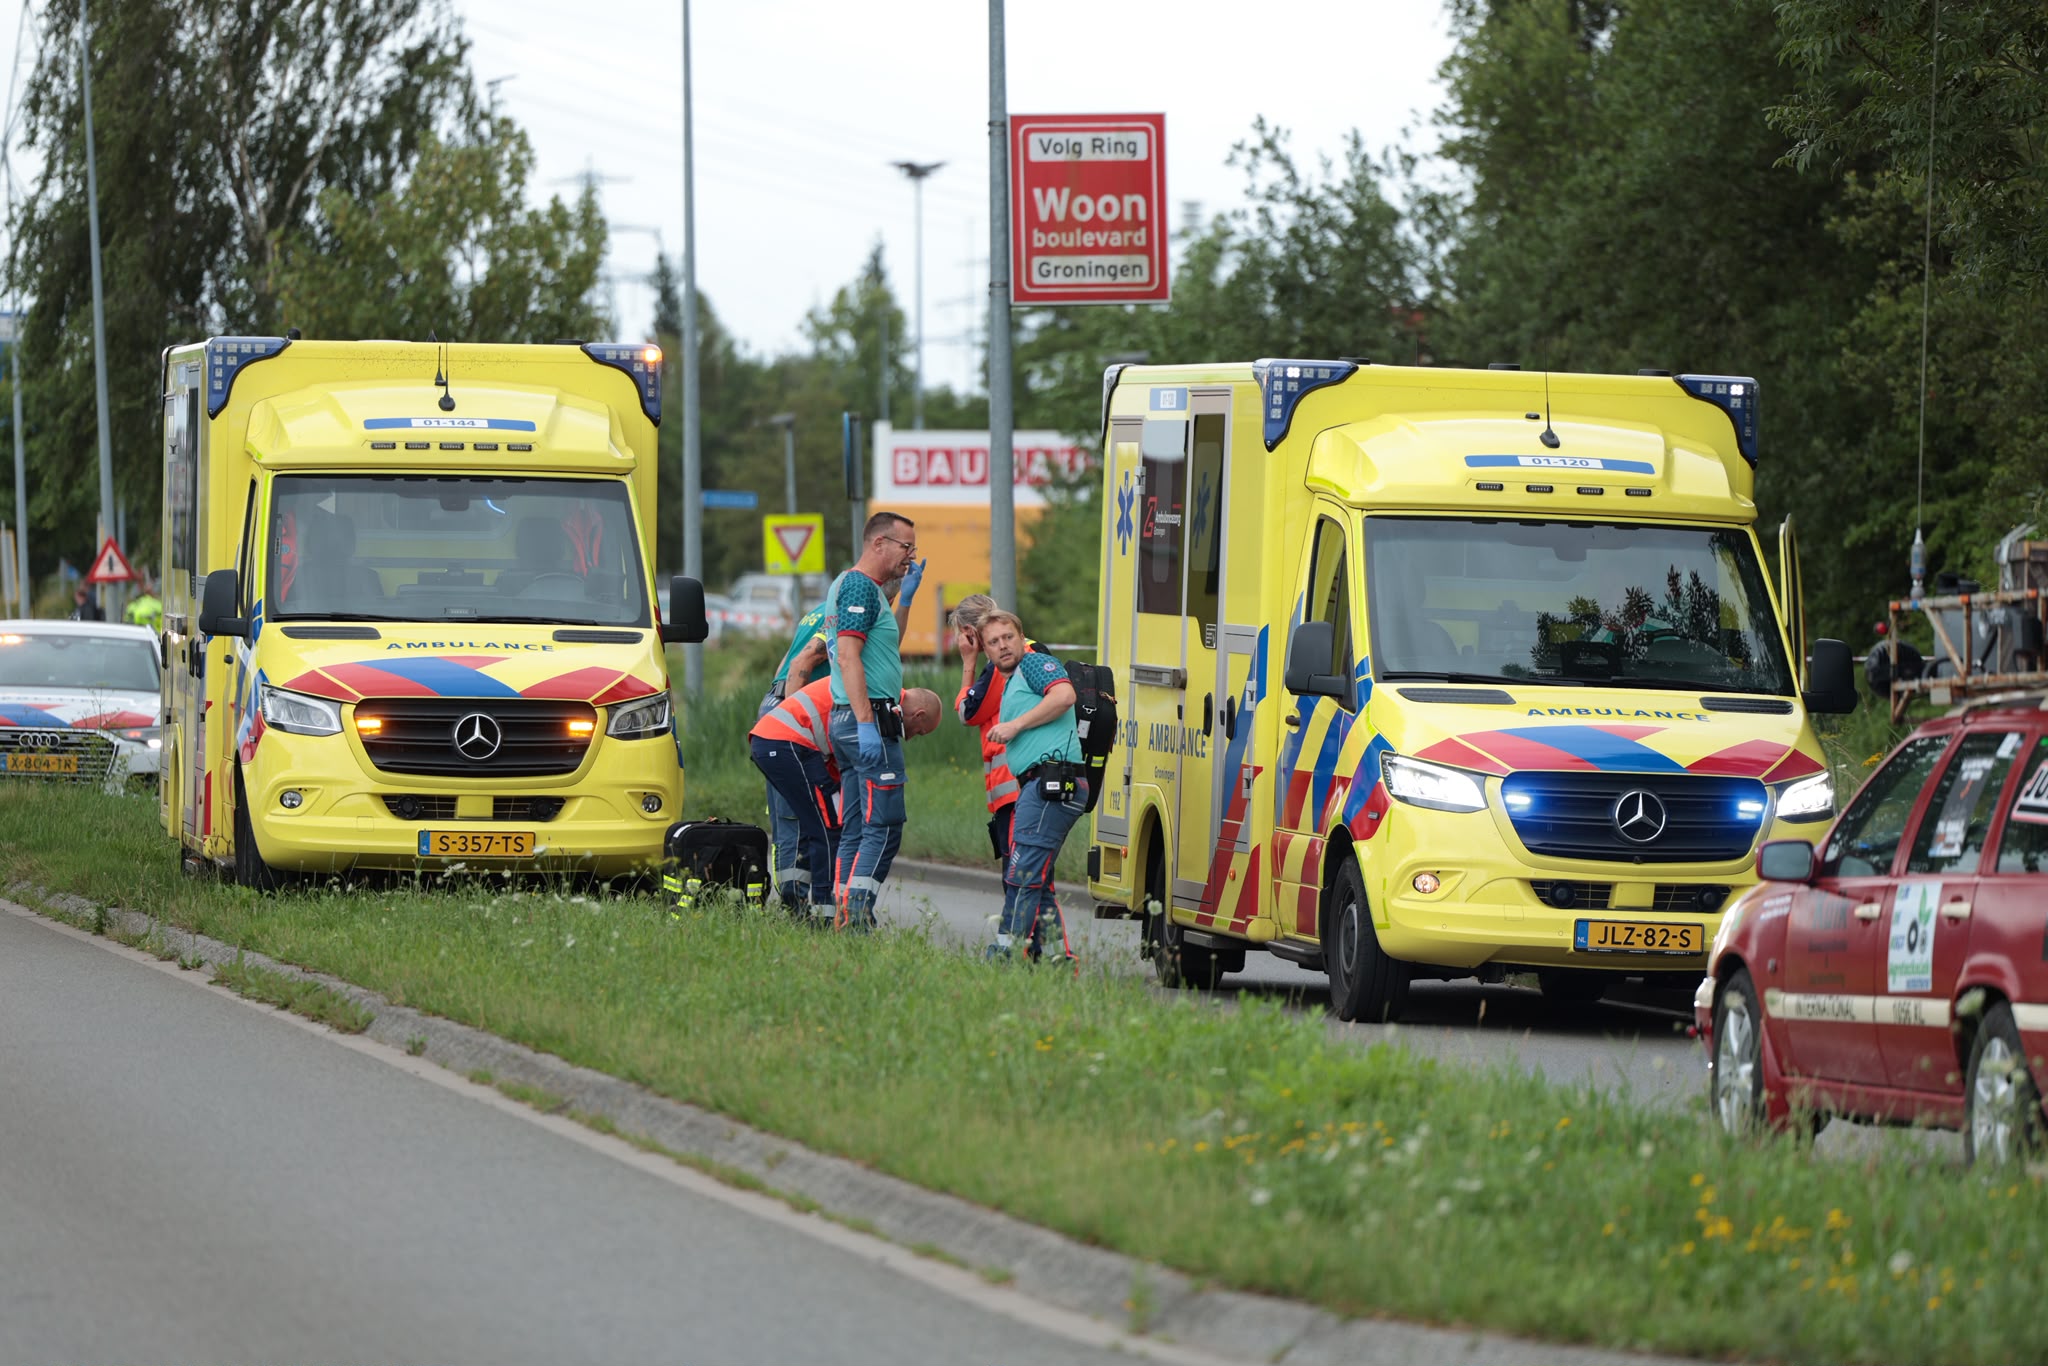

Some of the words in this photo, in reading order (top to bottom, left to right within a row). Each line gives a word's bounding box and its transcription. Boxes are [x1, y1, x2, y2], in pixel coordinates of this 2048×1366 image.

[1038, 137, 1083, 158] Volg
[1091, 136, 1138, 158] Ring
[1032, 186, 1148, 223] Woon
[1032, 226, 1148, 248] boulevard
[1037, 260, 1144, 281] Groningen
[423, 418, 477, 428] 01-144
[1531, 456, 1590, 468] 01-120
[386, 641, 555, 653] AMBULANCE
[1526, 707, 1712, 723] AMBULANCE
[1154, 765, 1175, 784] Groningen
[438, 834, 526, 853] S-357-TS
[1577, 936, 1587, 944] NL
[1597, 925, 1692, 949] JLZ-82-S
